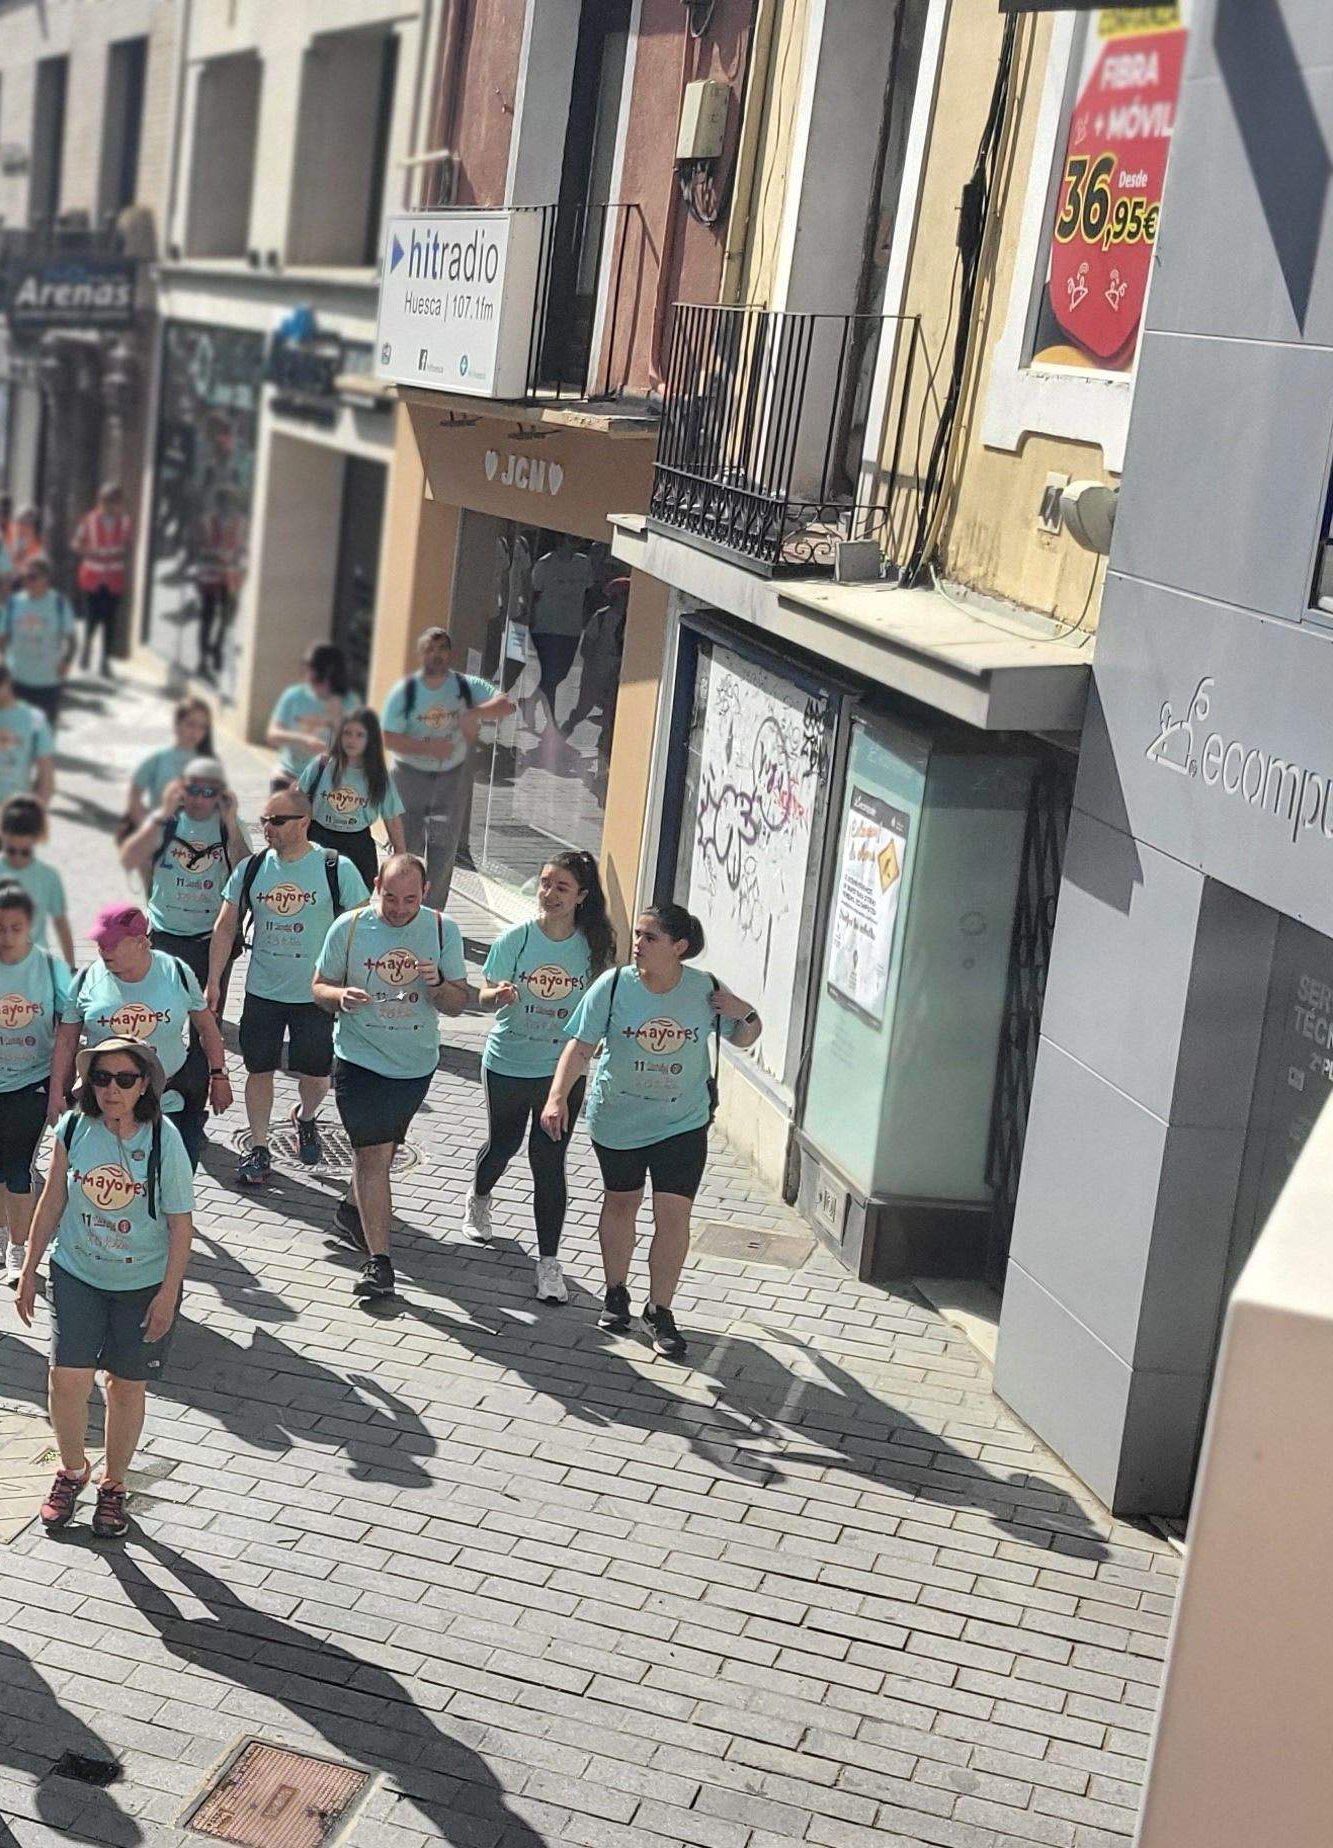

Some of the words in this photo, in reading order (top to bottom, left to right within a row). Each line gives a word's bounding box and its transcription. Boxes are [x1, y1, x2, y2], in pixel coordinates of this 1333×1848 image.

[1101, 52, 1159, 90] FIBRA
[1119, 170, 1148, 189] Desde
[408, 228, 499, 284] hitradio
[15, 277, 131, 308] Arenas
[405, 290, 442, 316] Huesca
[453, 296, 494, 321] 107.1fm
[256, 891, 316, 909] +mayores
[519, 971, 583, 990] +mayores
[97, 1009, 171, 1031] +mayores
[622, 1027, 699, 1046] +mayores
[72, 1171, 147, 1199] +mayores
